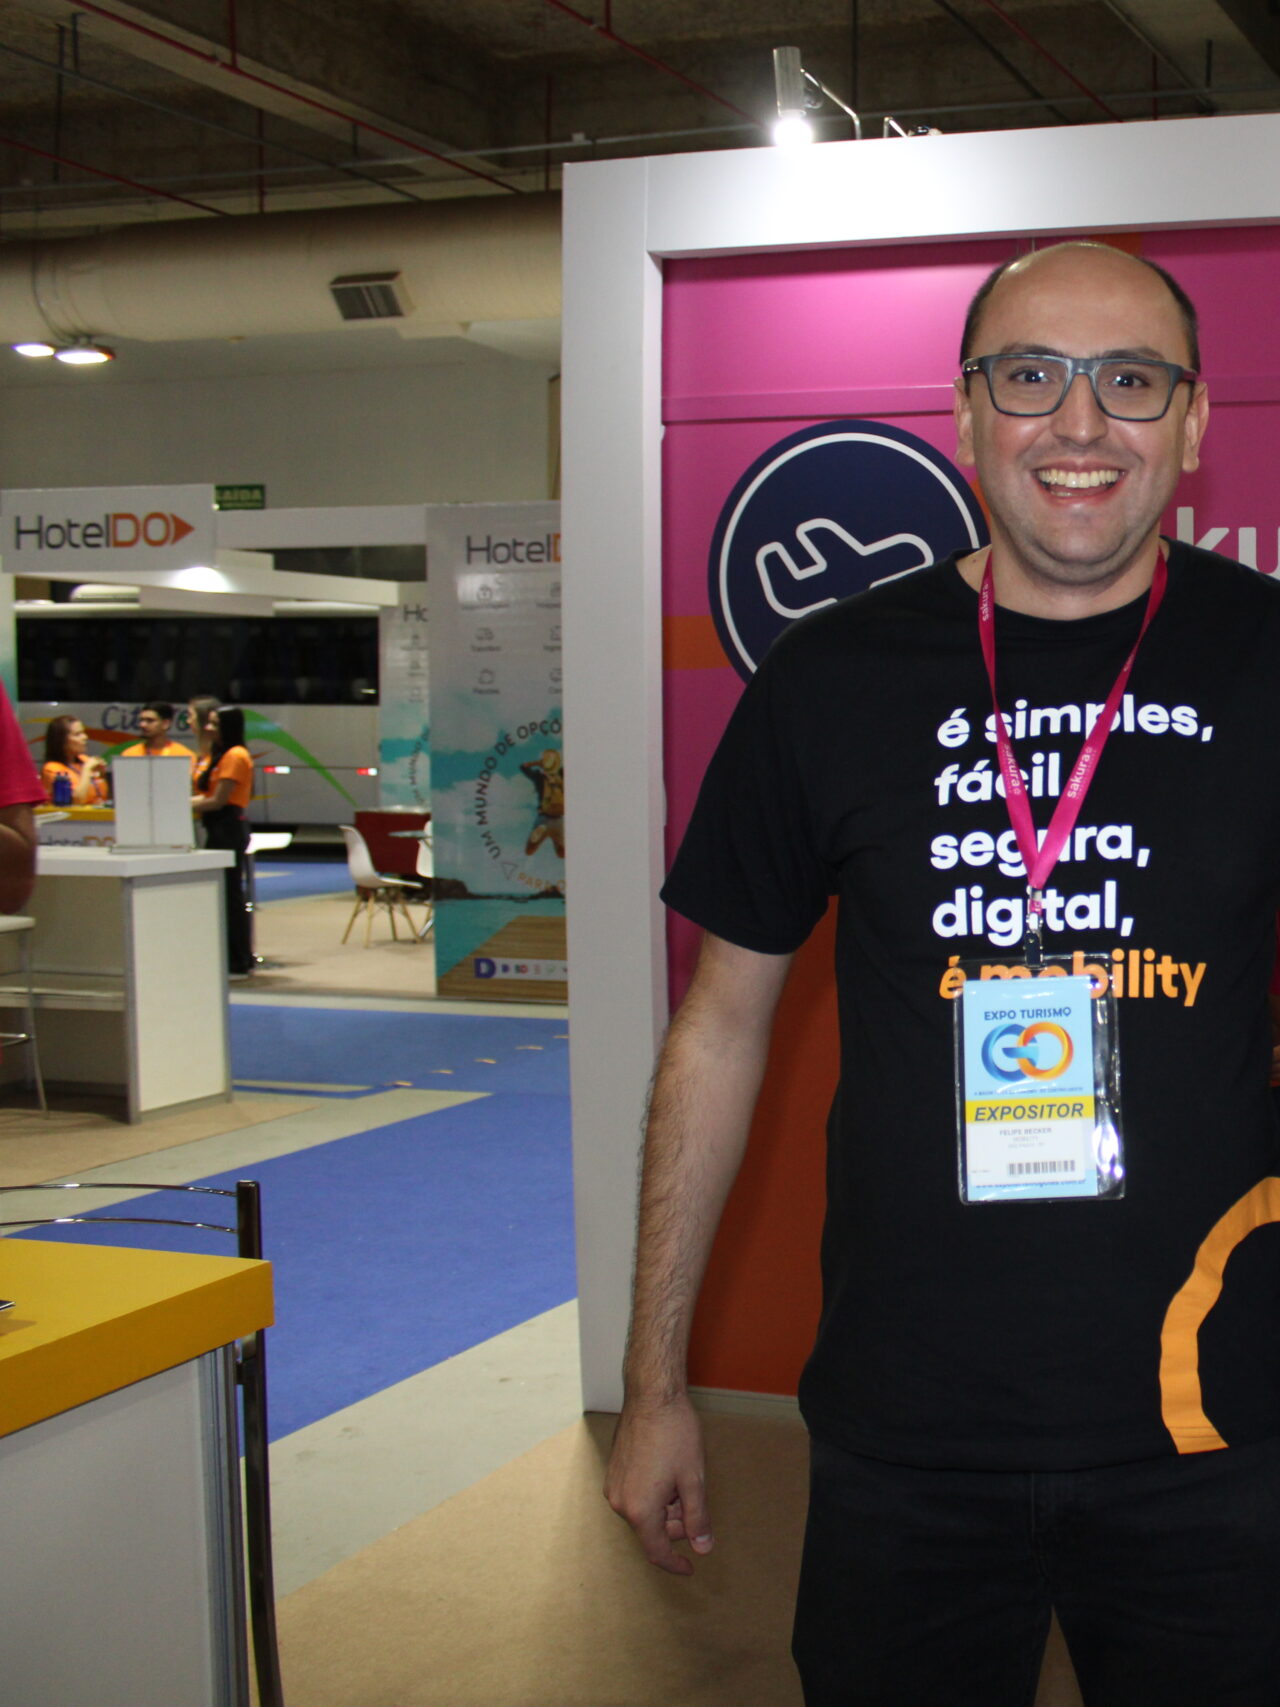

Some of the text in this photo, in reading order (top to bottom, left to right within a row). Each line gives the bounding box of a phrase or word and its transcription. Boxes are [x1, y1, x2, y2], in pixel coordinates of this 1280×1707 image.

[15, 511, 171, 550] HotelDO
[937, 708, 970, 748] é
[1067, 754, 1091, 798] sakura
[984, 1006, 1072, 1021] EXPO TURISMO
[974, 1102, 1084, 1122] EXPOSITOR
